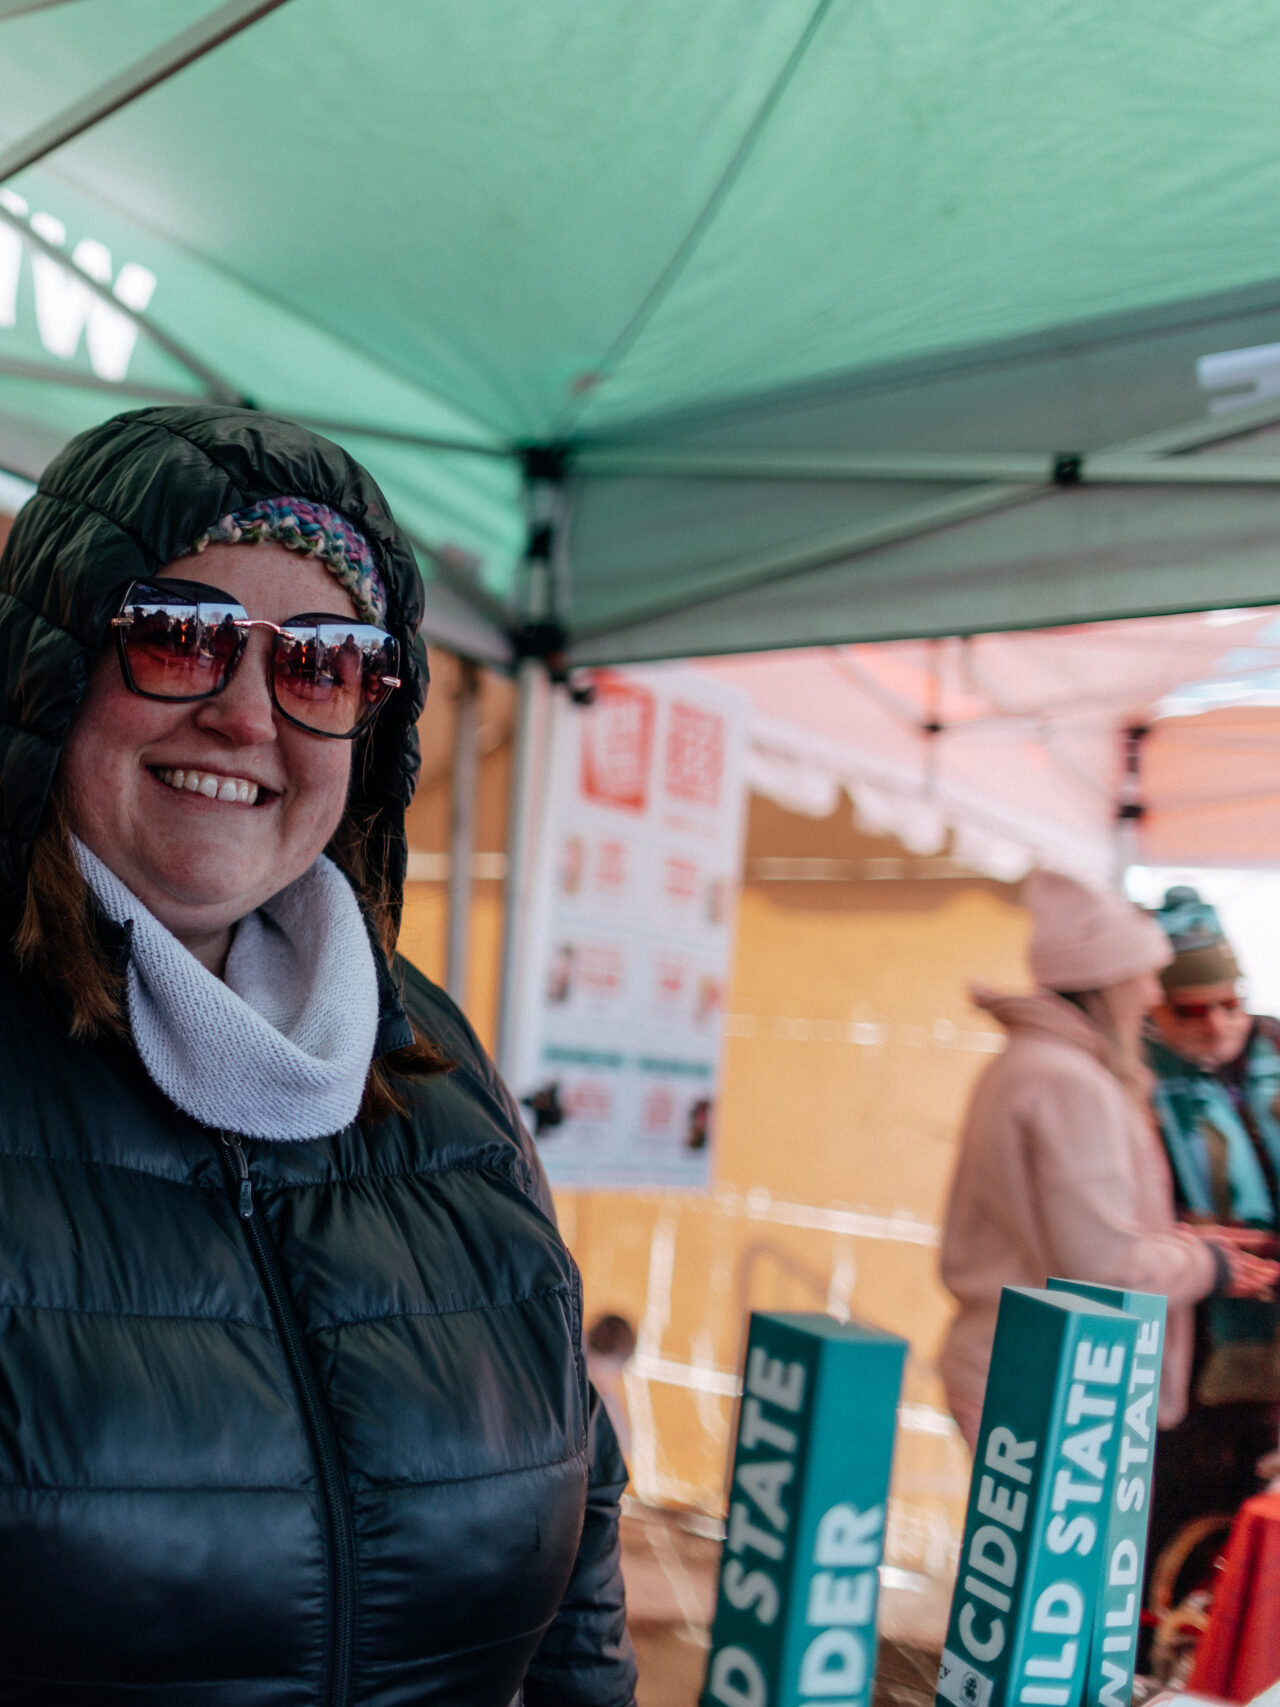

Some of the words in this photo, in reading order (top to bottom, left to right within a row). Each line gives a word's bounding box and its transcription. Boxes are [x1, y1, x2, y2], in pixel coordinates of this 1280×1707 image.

[723, 1347, 805, 1625] STATE
[1047, 1341, 1125, 1557] STATE
[1116, 1321, 1159, 1512] STATE
[798, 1503, 884, 1707] DER
[958, 1426, 1036, 1662] CIDER
